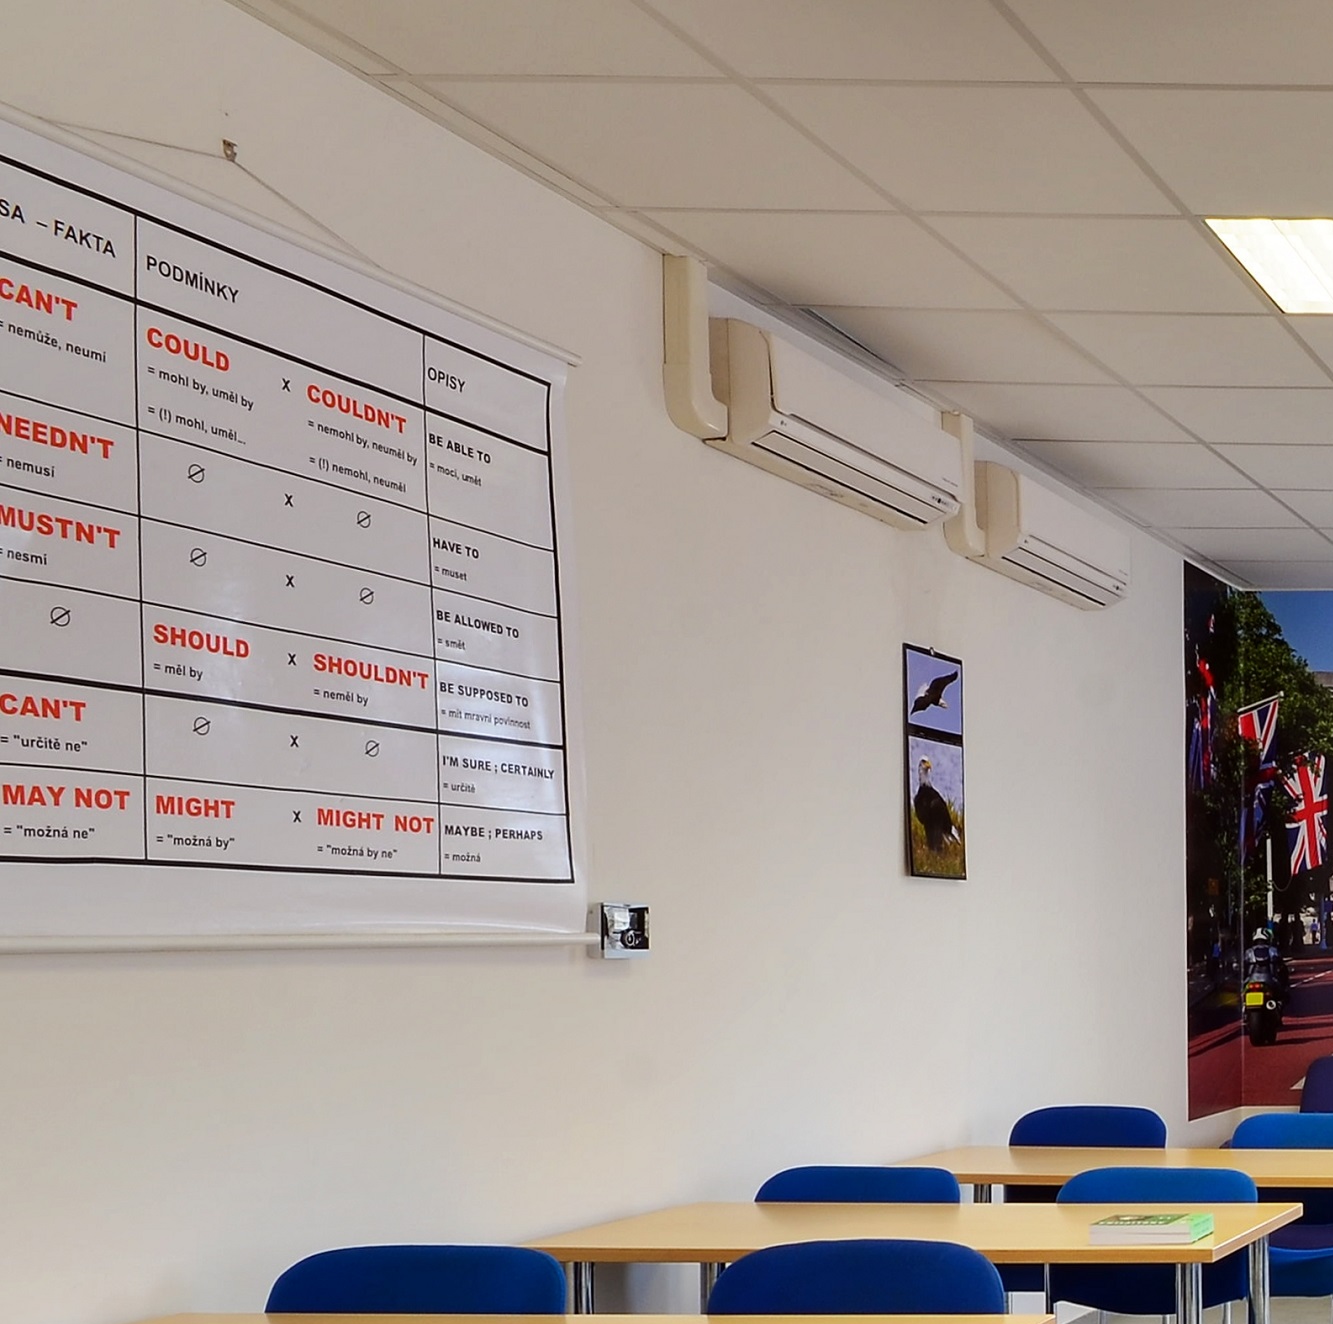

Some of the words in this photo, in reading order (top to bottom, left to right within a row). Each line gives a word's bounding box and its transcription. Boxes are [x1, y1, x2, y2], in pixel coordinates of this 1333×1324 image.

[54, 219, 116, 258] FAKTA
[146, 255, 239, 303] PODMÍNKY
[0, 278, 78, 321] CAN'T
[66, 342, 106, 363] neumí
[147, 327, 230, 372] COULD
[159, 369, 189, 387] mohl
[192, 378, 209, 395] by,
[212, 387, 238, 404] uměl
[241, 396, 254, 411] by
[427, 367, 466, 392] OPISY
[307, 384, 407, 433] COULDN'T
[0, 412, 114, 459] NEEDN'T
[175, 414, 208, 433] mohl,
[317, 423, 354, 442] nemohl
[356, 433, 370, 450] by,
[407, 449, 418, 466] by
[429, 433, 443, 447] BE
[446, 440, 474, 458] ABLE
[477, 449, 491, 463] TO
[7, 457, 55, 478] nemusí
[332, 462, 371, 484] nemohl,
[0, 504, 121, 548] MUSTN'T
[7, 549, 47, 565] nesmí
[433, 537, 462, 555] HAVE
[465, 545, 479, 559] TO
[442, 567, 467, 581] muset
[436, 609, 450, 624] BE
[454, 613, 503, 635] ALLOWED
[506, 626, 519, 639] TO
[153, 624, 250, 659] SHOULD
[165, 663, 185, 677] měl
[189, 666, 203, 681] by
[313, 653, 429, 689] SHOULDN'T
[323, 689, 354, 704] neměl
[356, 693, 368, 706] by
[440, 681, 455, 694] BE
[457, 685, 513, 704] SUPPOSED
[515, 694, 529, 707] TO
[0, 693, 86, 722] CAN'T
[442, 755, 459, 768] I'M
[462, 758, 492, 772] SURE
[500, 760, 555, 780] CERTAINLY
[2, 784, 65, 807] MAY
[74, 787, 130, 810] NOT
[155, 795, 235, 819] MIGHT
[317, 808, 385, 830] MIGHT
[394, 815, 434, 834] NOT
[445, 825, 485, 838] MAYBE
[495, 828, 543, 841] PERHAPS
[367, 846, 379, 859] by
